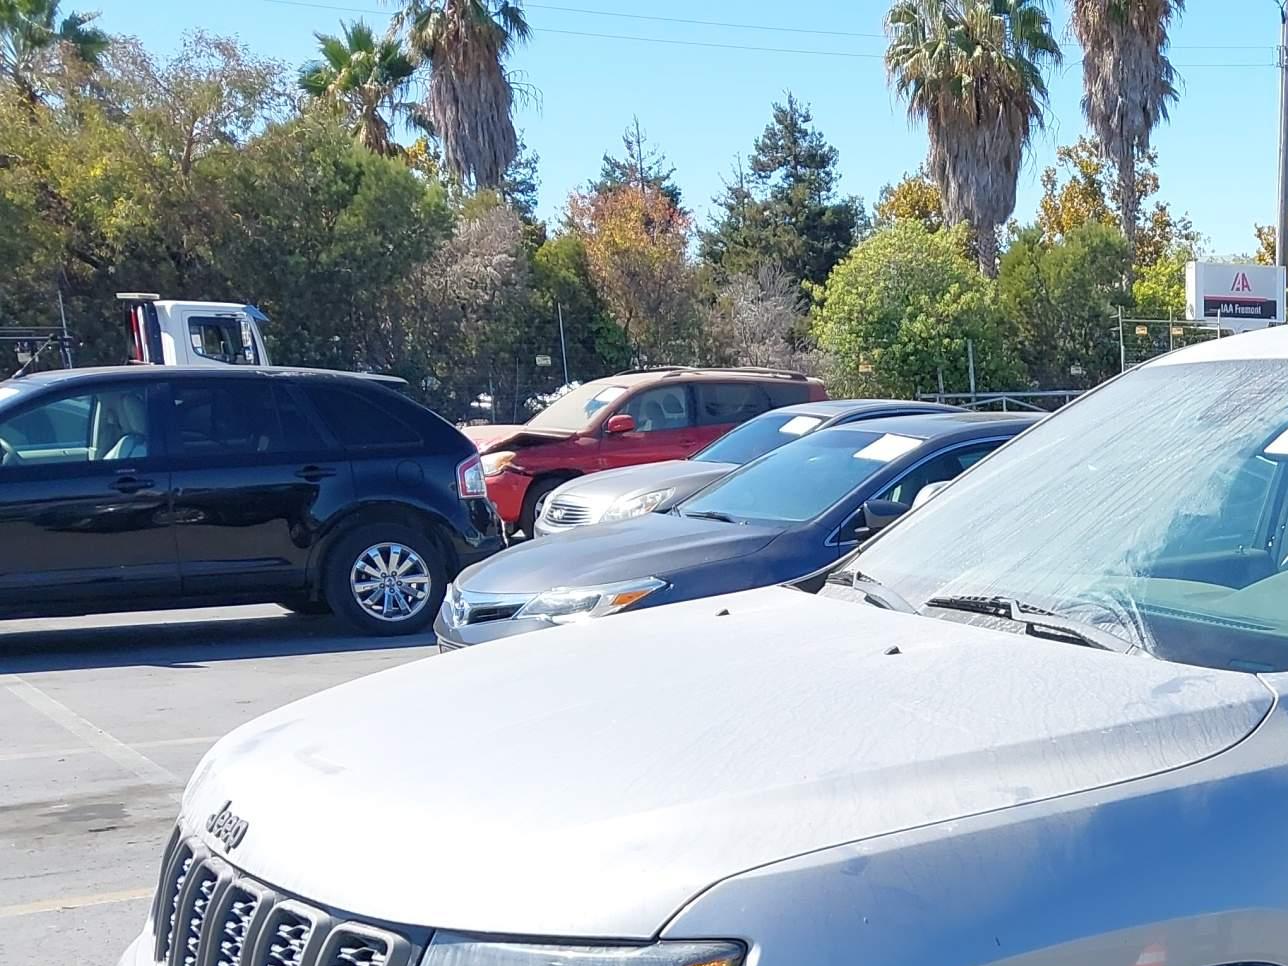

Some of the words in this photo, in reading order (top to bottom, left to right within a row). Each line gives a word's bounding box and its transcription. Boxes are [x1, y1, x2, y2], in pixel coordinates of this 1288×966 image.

[1220, 303, 1234, 314] IAA
[1235, 304, 1262, 315] Fremont
[206, 800, 249, 855] Jeep
